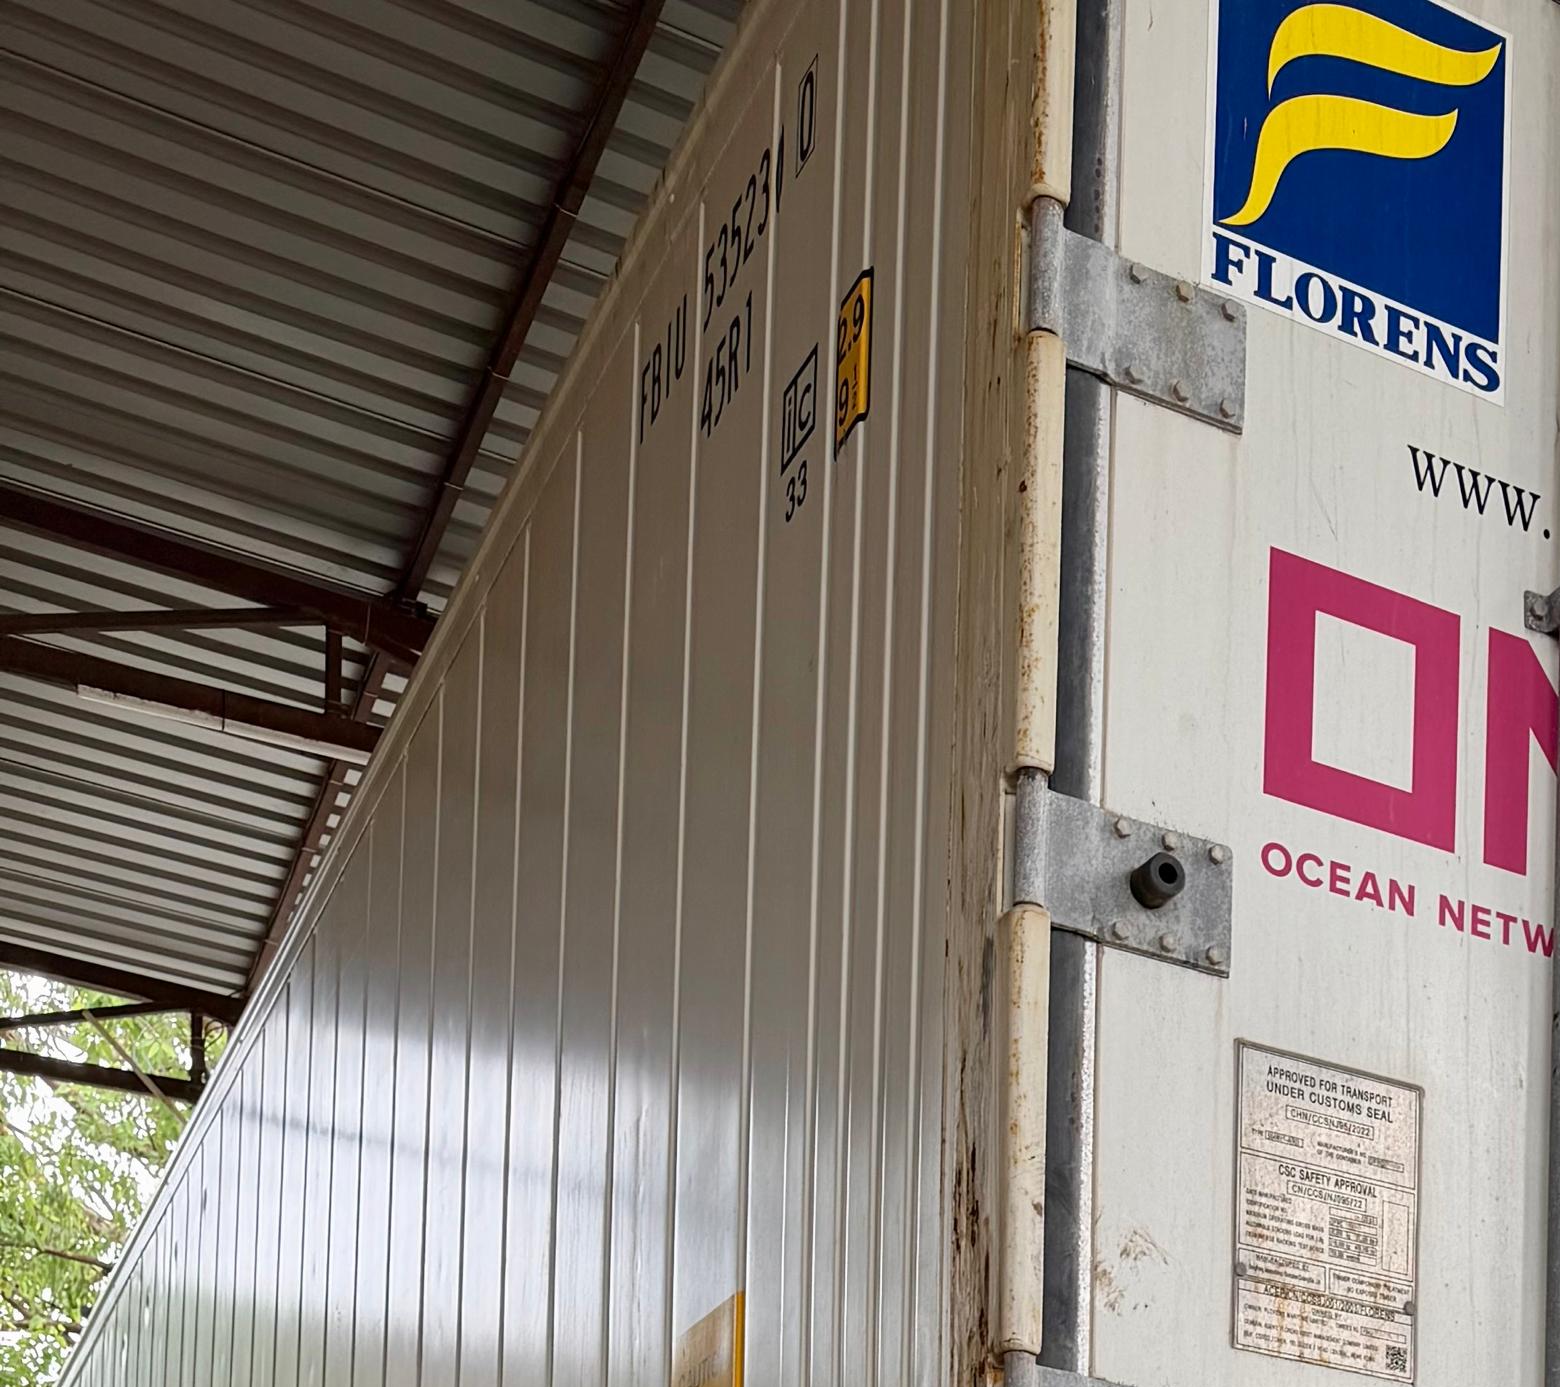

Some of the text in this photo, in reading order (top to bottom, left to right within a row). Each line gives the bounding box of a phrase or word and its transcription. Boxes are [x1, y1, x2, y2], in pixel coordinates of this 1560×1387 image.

[640, 294, 688, 444] FBIU
[800, 70, 815, 164] 0
[1210, 232, 1500, 394] FLORENS
[701, 290, 753, 437] 45R1
[784, 459, 808, 523] 33
[1260, 841, 1417, 917] OCEAN
[1266, 1080, 1393, 1123] UNDER CUSTOMS SEAL
[1267, 1064, 1392, 1108] APPROVED FOR TRANSPORT
[1278, 1164, 1376, 1198] CSC SAFETY APPROVAL
